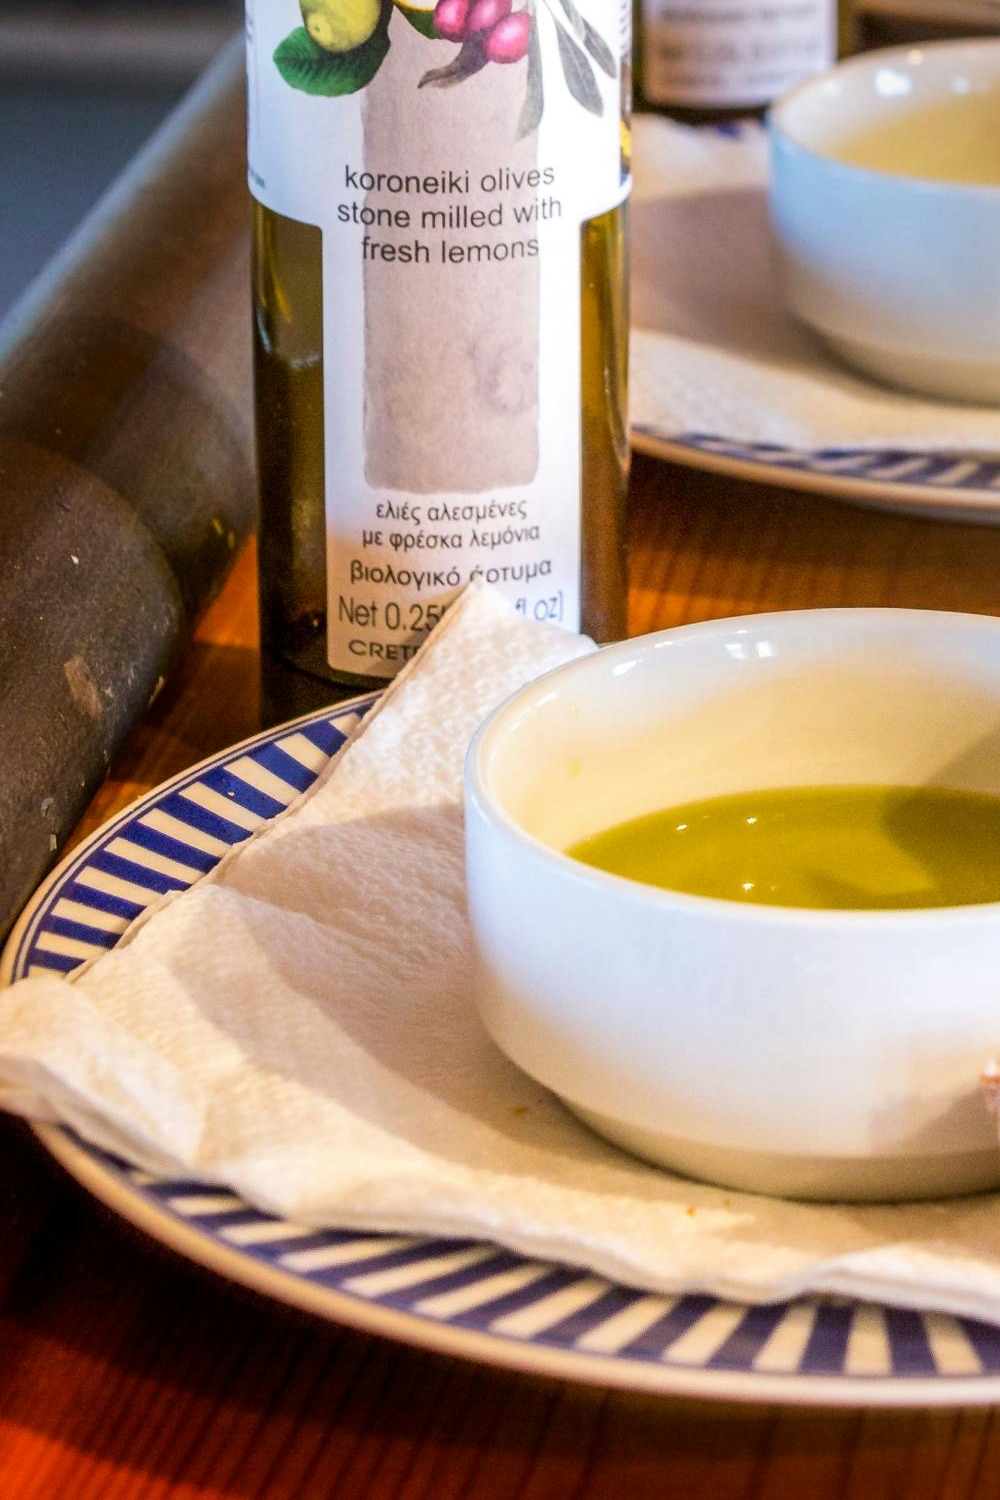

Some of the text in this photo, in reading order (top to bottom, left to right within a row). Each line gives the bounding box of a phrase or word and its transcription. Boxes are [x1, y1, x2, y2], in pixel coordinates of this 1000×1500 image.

[344, 164, 556, 194] koroneiki olives
[337, 196, 563, 229] stone milled with
[362, 236, 540, 264] fresh lemons
[376, 499, 528, 525] ελιές αλεσμένες
[362, 524, 541, 552] με φρέσκα λεμόνια
[350, 558, 461, 591] βιολογικό
[338, 595, 378, 628] Net
